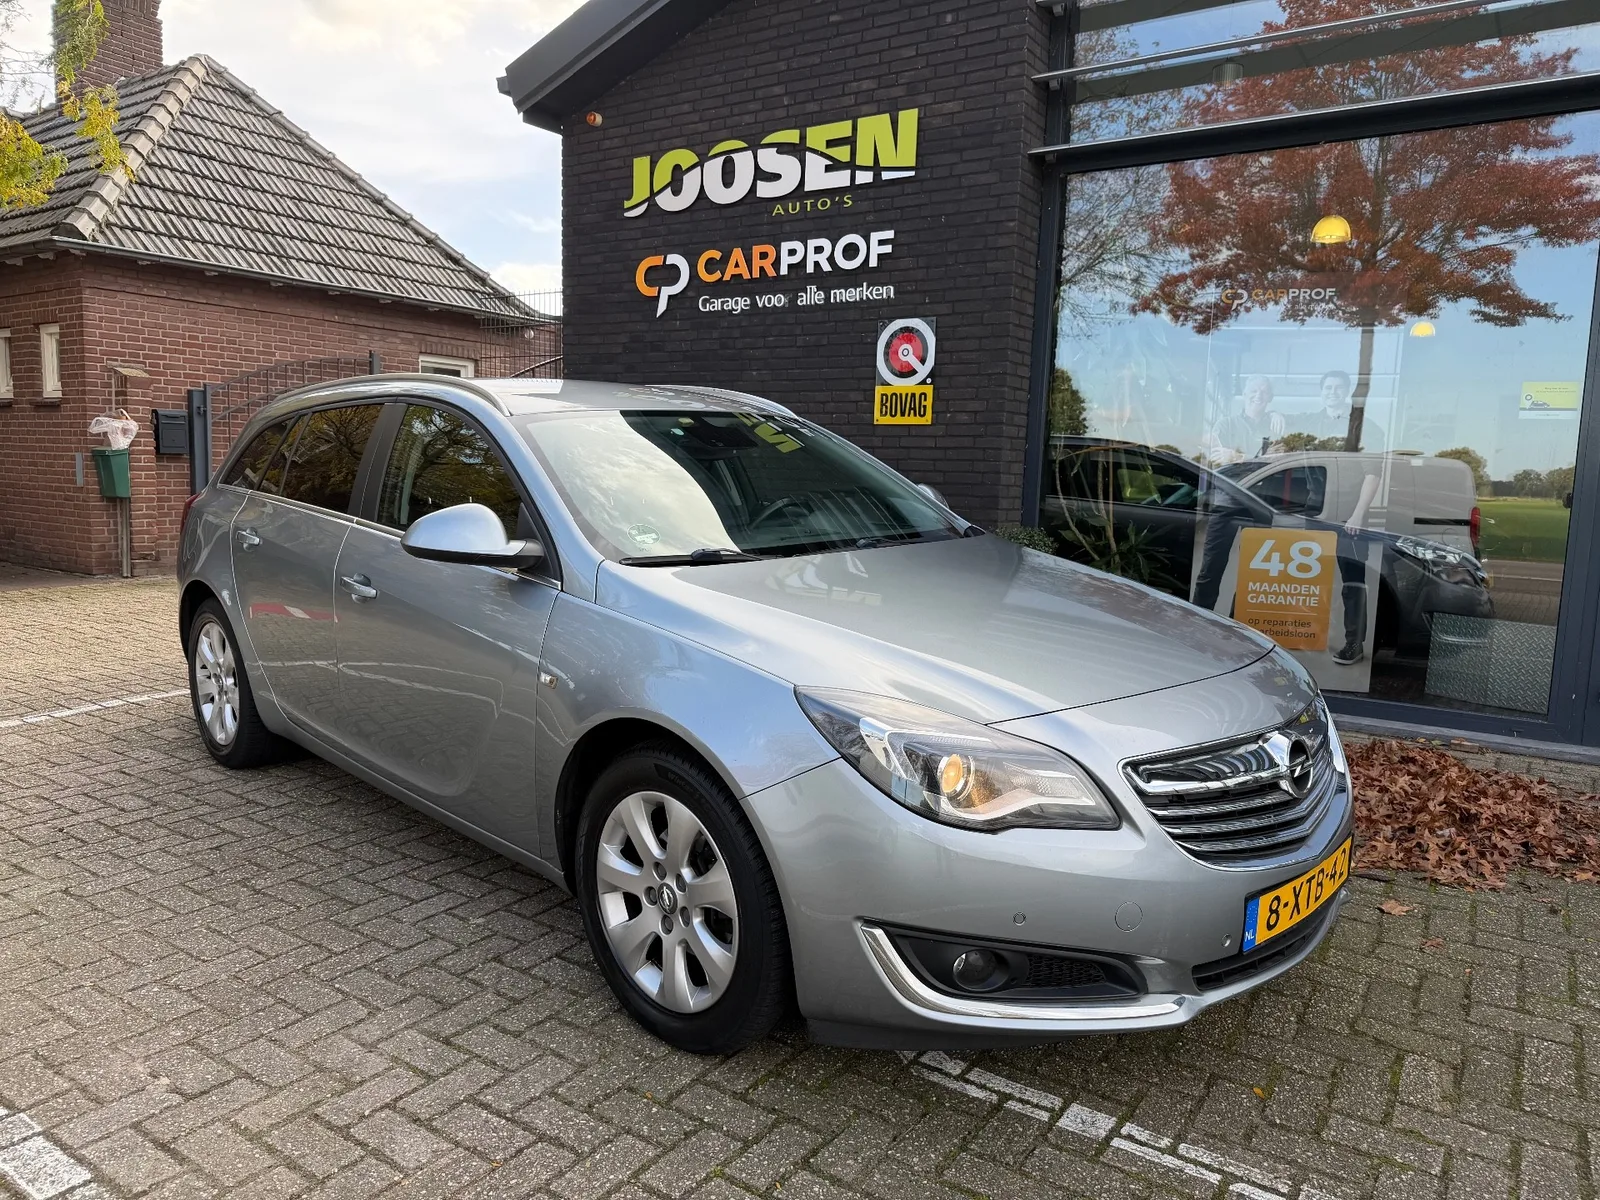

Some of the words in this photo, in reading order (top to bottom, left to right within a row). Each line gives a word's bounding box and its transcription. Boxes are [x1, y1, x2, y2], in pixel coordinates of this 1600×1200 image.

[624, 108, 919, 218] JOOSEN
[772, 194, 853, 216] AUTO'S
[697, 230, 895, 283] CARPROF
[698, 295, 751, 314] Garage
[797, 285, 825, 306] alle
[830, 282, 895, 303] merken
[879, 392, 928, 420] BOVAG
[1249, 539, 1322, 579] 48
[1247, 594, 1319, 607] GARANTIE
[1248, 582, 1320, 595] MAANDEN
[1248, 618, 1260, 627] op
[1262, 618, 1312, 629] reparaties
[1266, 847, 1346, 931] 8-XTB-42
[1244, 929, 1254, 942] NL
